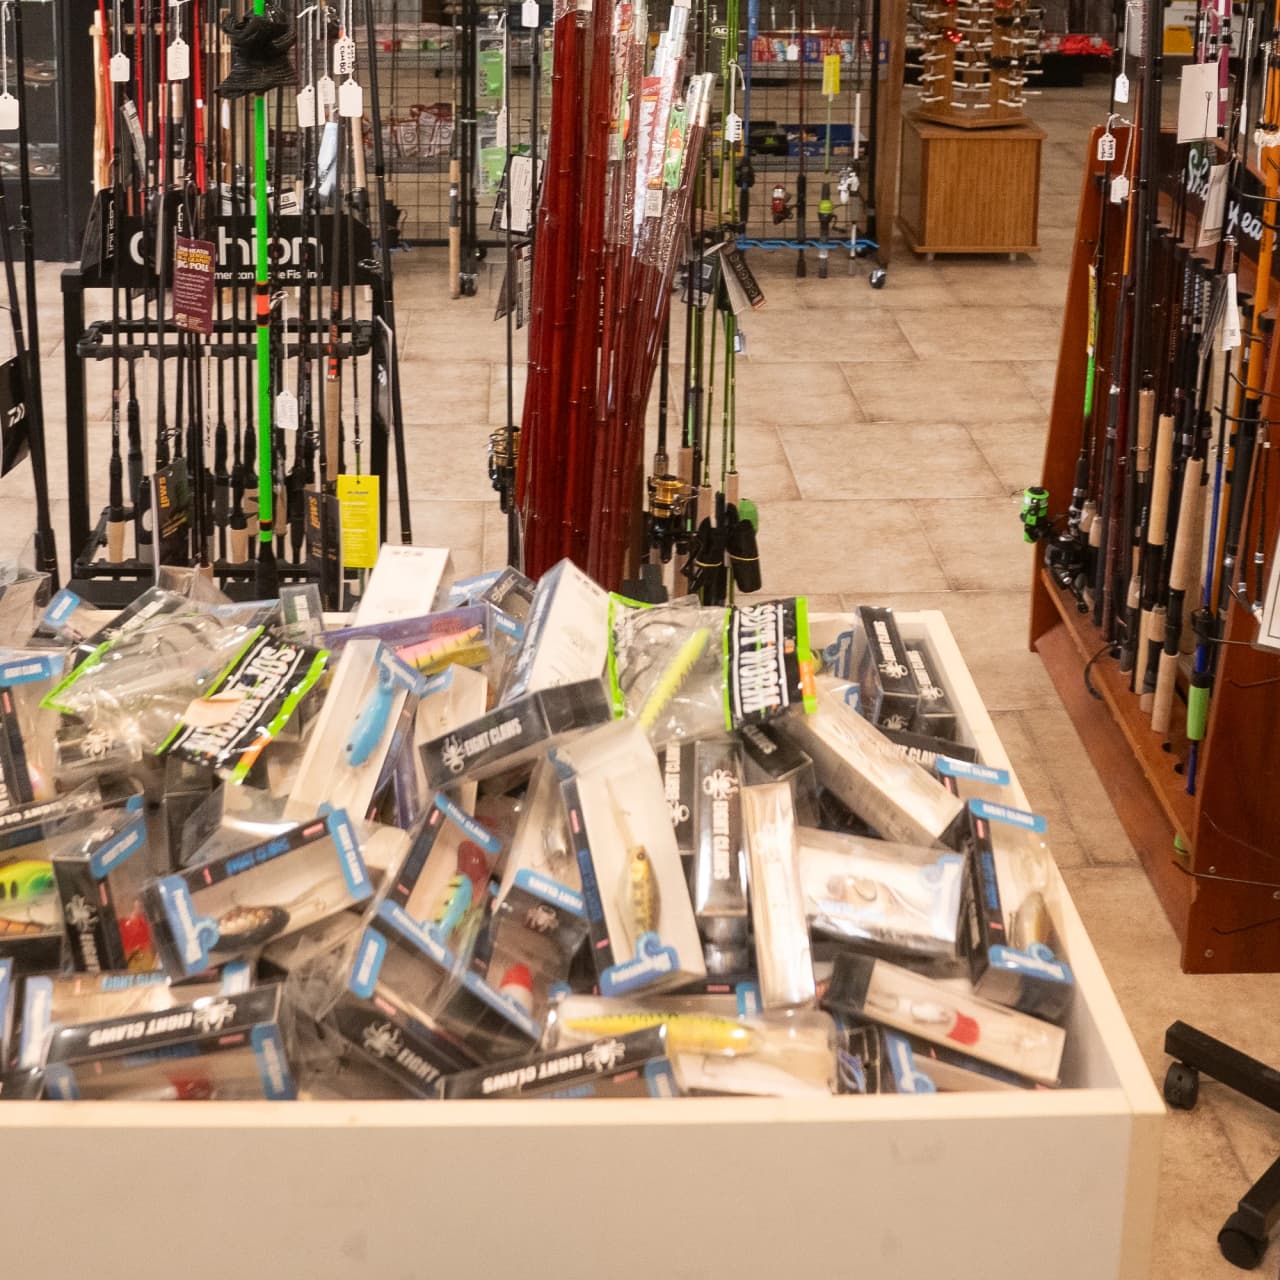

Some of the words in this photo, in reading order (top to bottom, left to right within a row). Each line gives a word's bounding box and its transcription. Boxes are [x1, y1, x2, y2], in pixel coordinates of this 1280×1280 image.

[130, 225, 324, 266] Chion
[189, 263, 209, 272] POLE
[740, 604, 778, 645] SOFT
[233, 645, 297, 699] SOFT
[88, 1022, 146, 1047] CLAWS
[145, 1011, 193, 1036] EIGHT
